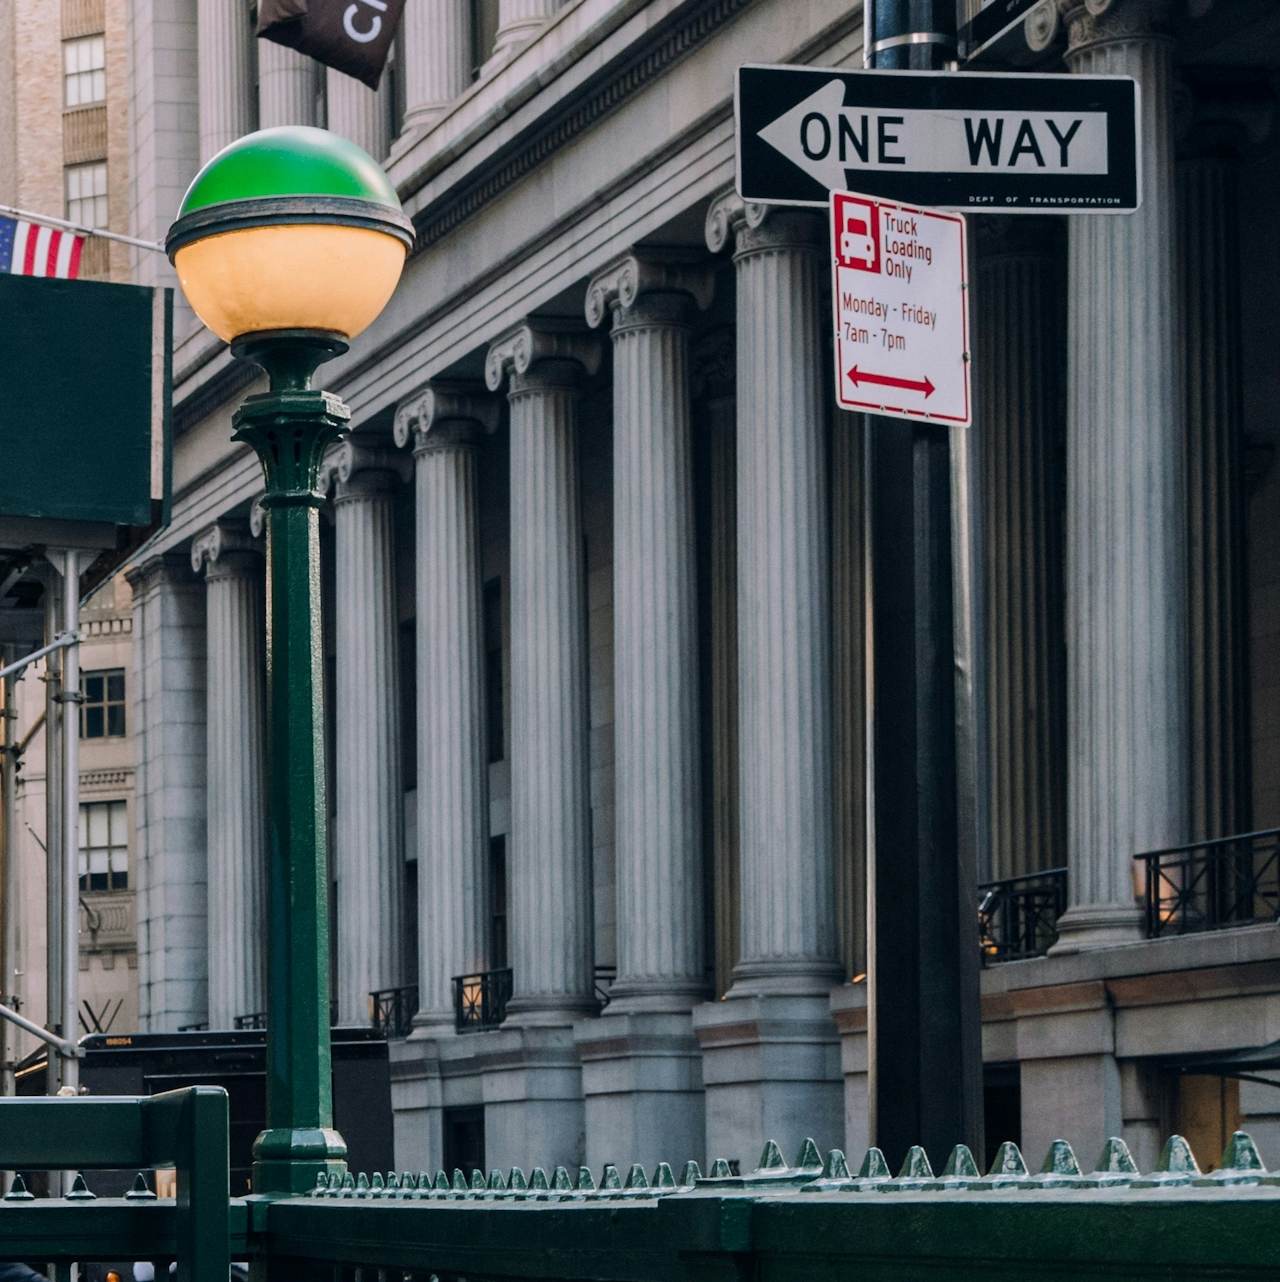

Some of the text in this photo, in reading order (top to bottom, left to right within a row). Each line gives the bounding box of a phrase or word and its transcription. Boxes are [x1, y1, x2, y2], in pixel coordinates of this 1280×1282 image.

[800, 111, 1083, 167] ONE WAY
[969, 195, 995, 203] DEPT
[1029, 196, 1121, 204] TRANSPORTATION
[884, 212, 918, 236] Truck
[885, 235, 932, 265] Loading
[886, 258, 912, 284] Only
[843, 292, 888, 322] Monday
[902, 303, 937, 331] Friday
[844, 322, 869, 344] 7am
[881, 328, 906, 352] 7pm
